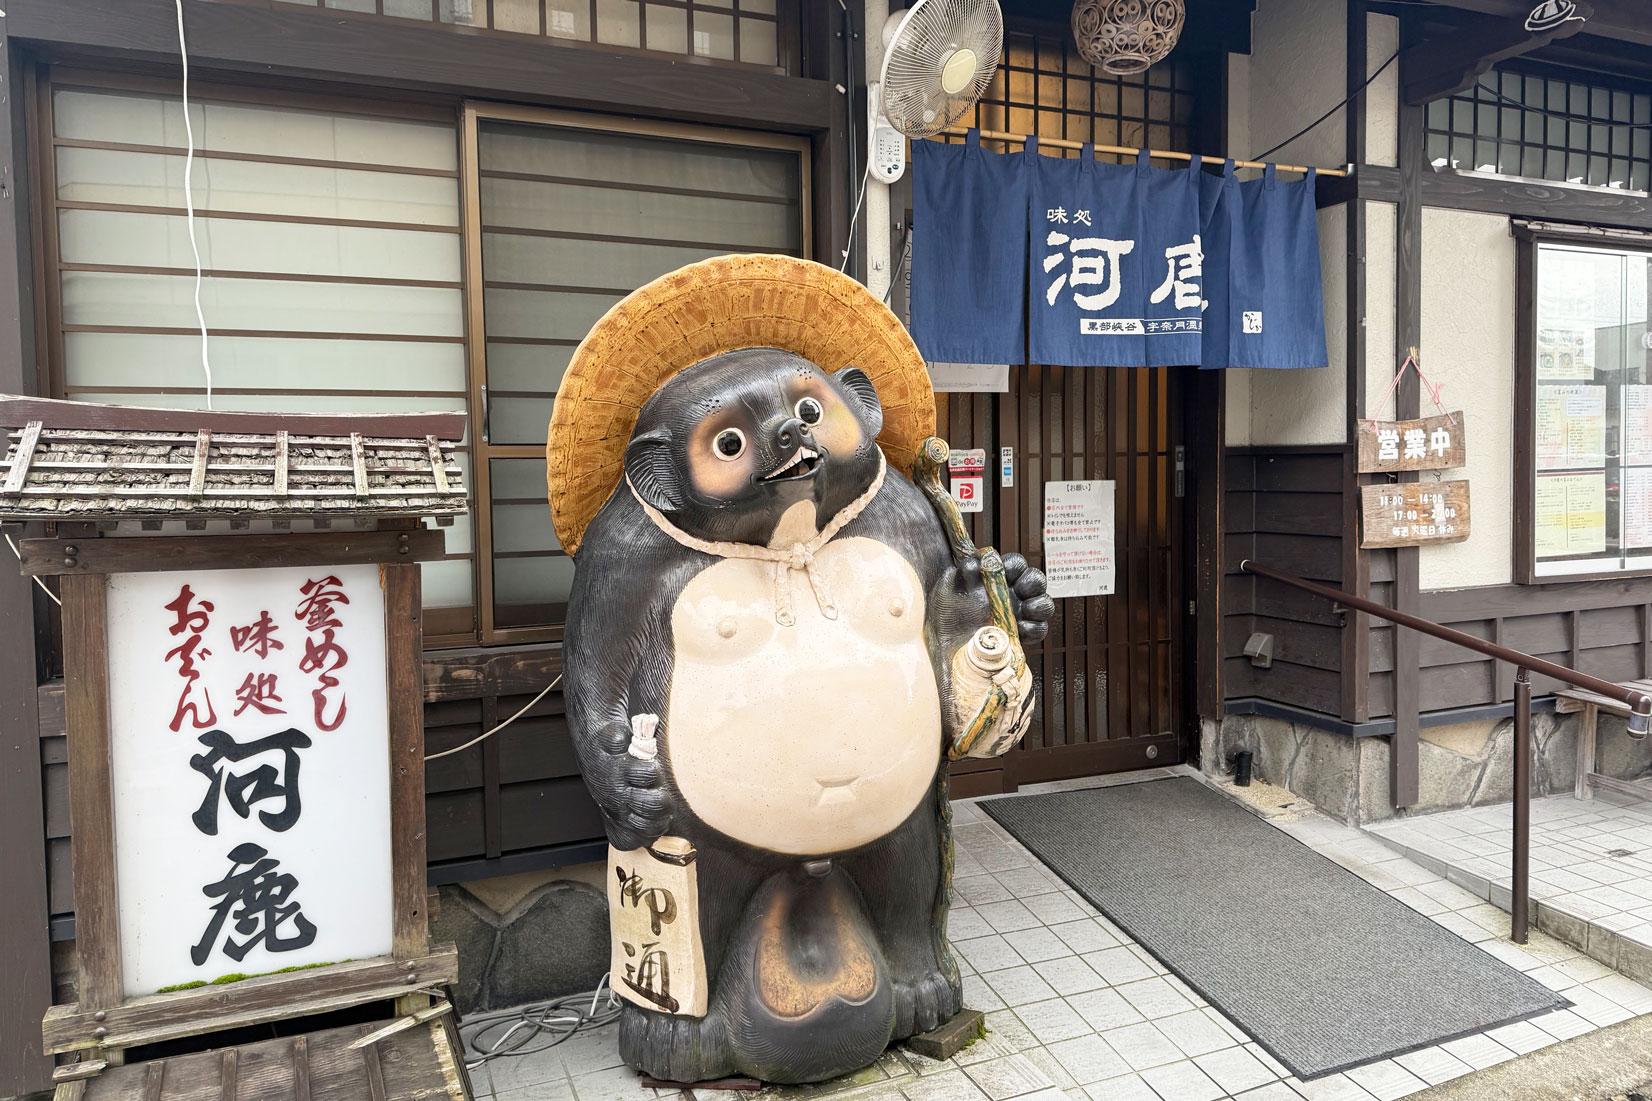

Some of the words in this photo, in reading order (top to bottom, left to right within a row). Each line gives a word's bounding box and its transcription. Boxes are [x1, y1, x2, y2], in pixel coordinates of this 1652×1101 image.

[1046, 205, 1093, 227] 味処
[1087, 321, 1138, 333] 黒部峡谷
[1146, 320, 1202, 333] 宇奈月温
[1377, 426, 1451, 460] 営業中
[164, 583, 219, 733] おでん
[229, 610, 288, 718] 味処
[294, 575, 350, 732] 釜めし
[189, 727, 318, 967] 河鹿
